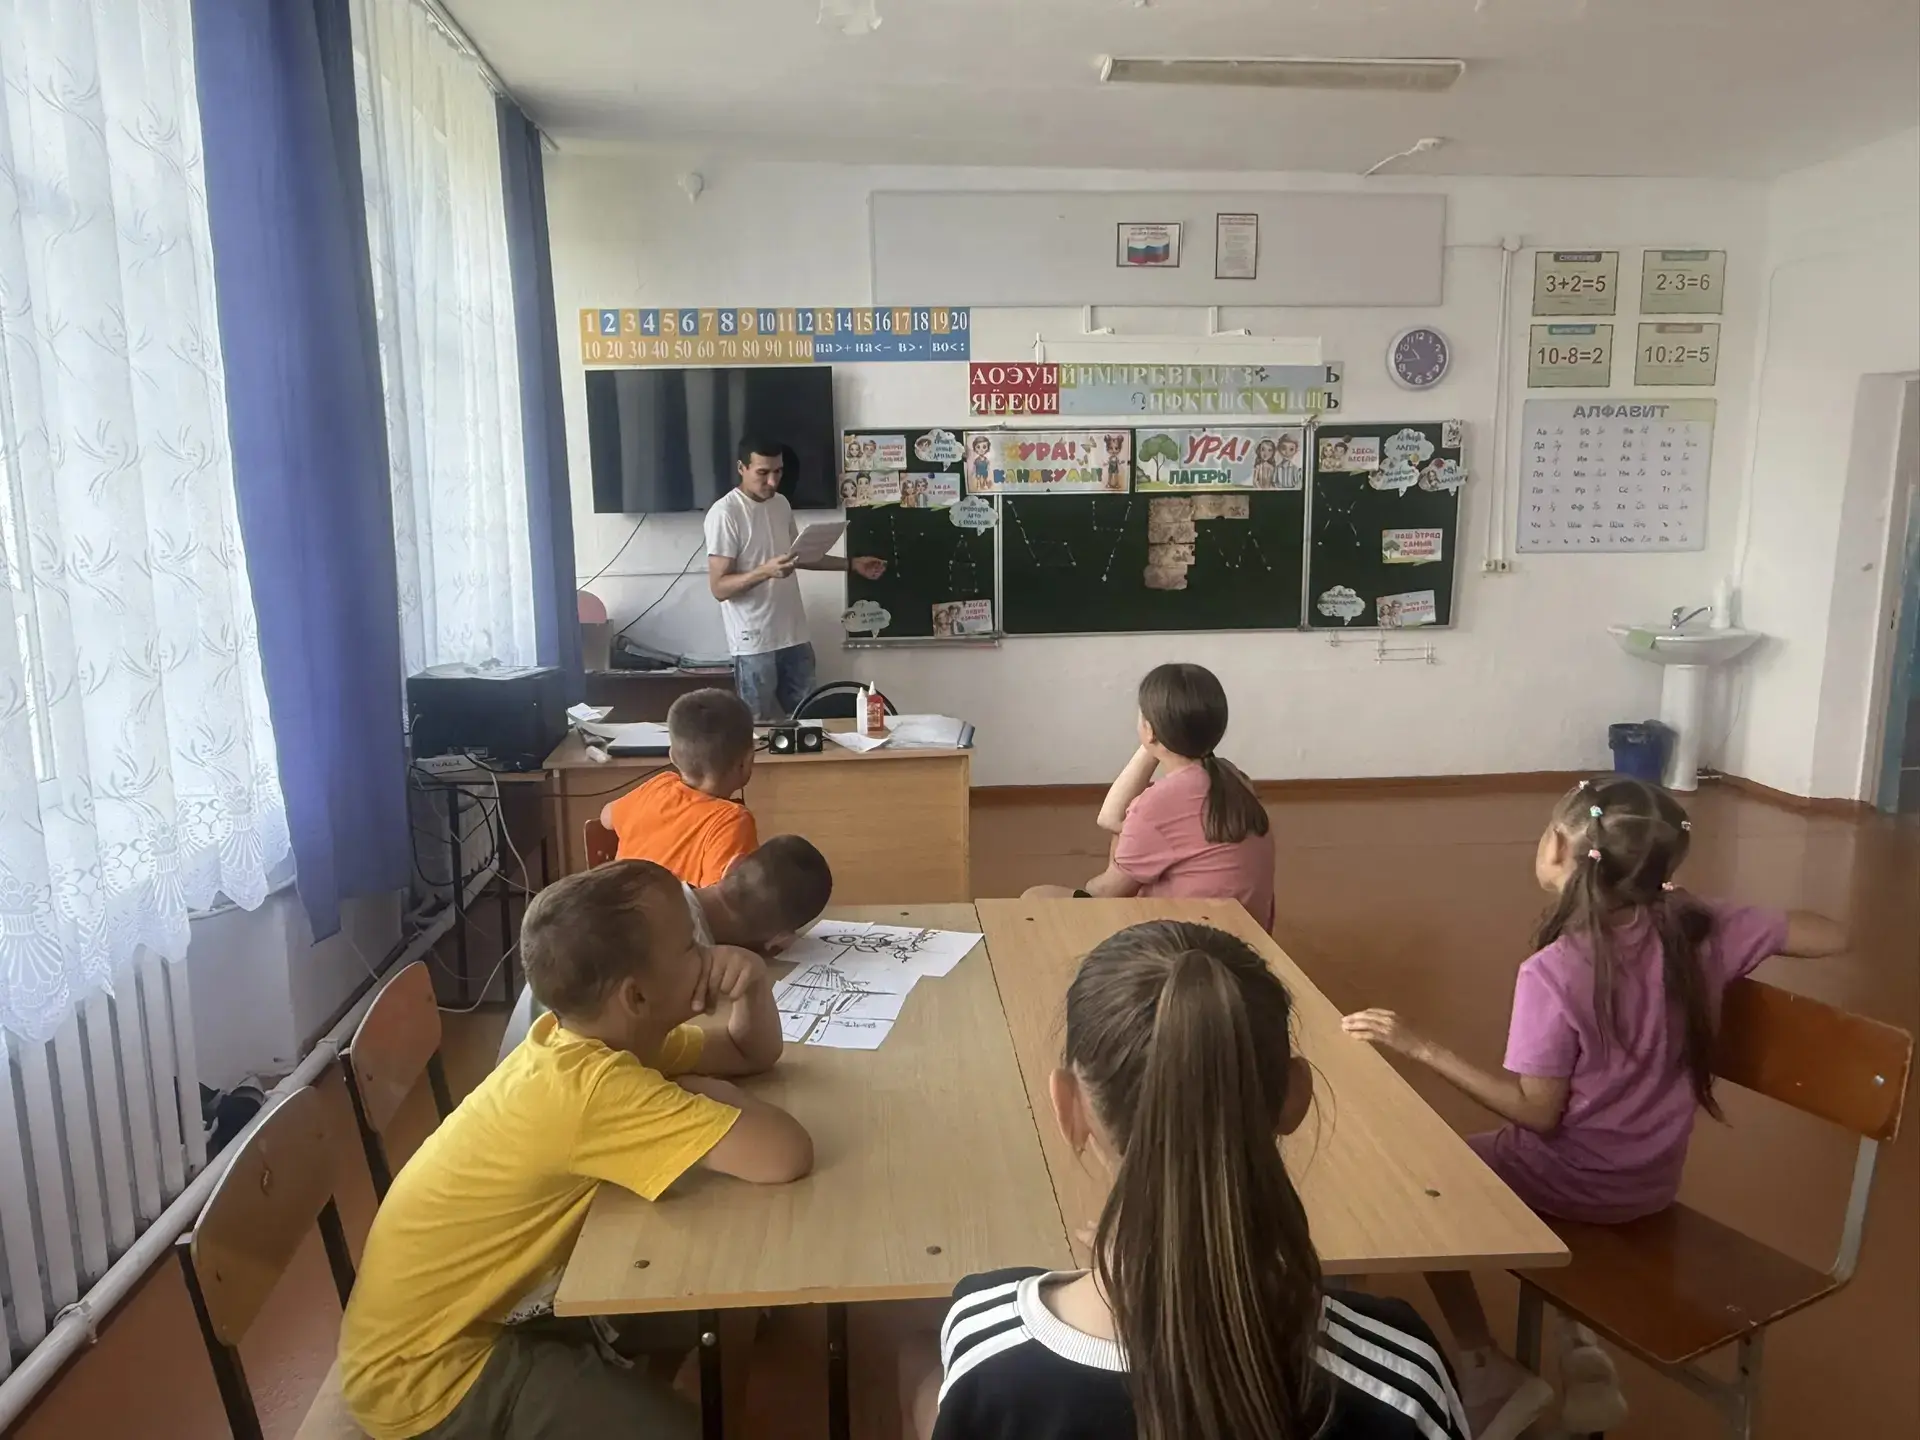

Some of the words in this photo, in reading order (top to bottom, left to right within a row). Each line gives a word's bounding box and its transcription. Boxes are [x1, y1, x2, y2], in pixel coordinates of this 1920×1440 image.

[1546, 275, 1606, 292] 3+2=5
[584, 313, 594, 332] 1
[604, 313, 616, 332] 2
[625, 313, 636, 332] 3
[643, 313, 655, 332] 4
[663, 313, 675, 332] 5
[682, 313, 694, 332] 6
[702, 313, 714, 332] 7
[720, 313, 734, 332] 8
[741, 313, 753, 332] 9
[759, 313, 775, 332] 10
[779, 312, 793, 331] 11
[797, 312, 813, 331] 12
[817, 312, 833, 331] 13
[836, 312, 852, 331] 14
[856, 312, 872, 331] 15
[875, 312, 891, 331] 16
[895, 312, 910, 331] 17
[914, 312, 929, 331] 18
[932, 312, 948, 331] 19
[951, 312, 967, 331] 20
[1416, 332, 1424, 340] 12
[1429, 336, 1432, 344] 1
[584, 341, 600, 358] 10
[606, 341, 623, 358] 20
[629, 341, 646, 358] 30
[651, 341, 668, 358] 40
[674, 341, 692, 358] 50
[698, 341, 714, 358] 60
[719, 341, 736, 358] 70
[742, 341, 759, 358] 80
[765, 341, 782, 358] 90
[788, 341, 812, 358] 100
[1435, 344, 1441, 352] 2
[1396, 353, 1402, 362] 9
[1437, 354, 1444, 363] 3
[1537, 347, 1603, 364] 10-8=2
[1645, 346, 1710, 363] 10:2=5
[1398, 363, 1406, 372] 8
[1432, 364, 1439, 373] 4
[1406, 372, 1412, 380] 7
[1415, 375, 1422, 384] 6
[1426, 372, 1432, 380] 5
[1572, 405, 1670, 418] АЛФАВИТ
[1018, 441, 1076, 461] УРА!
[1184, 435, 1251, 464] УРА!
[1169, 470, 1232, 485] ЛАГЕРЬ!
